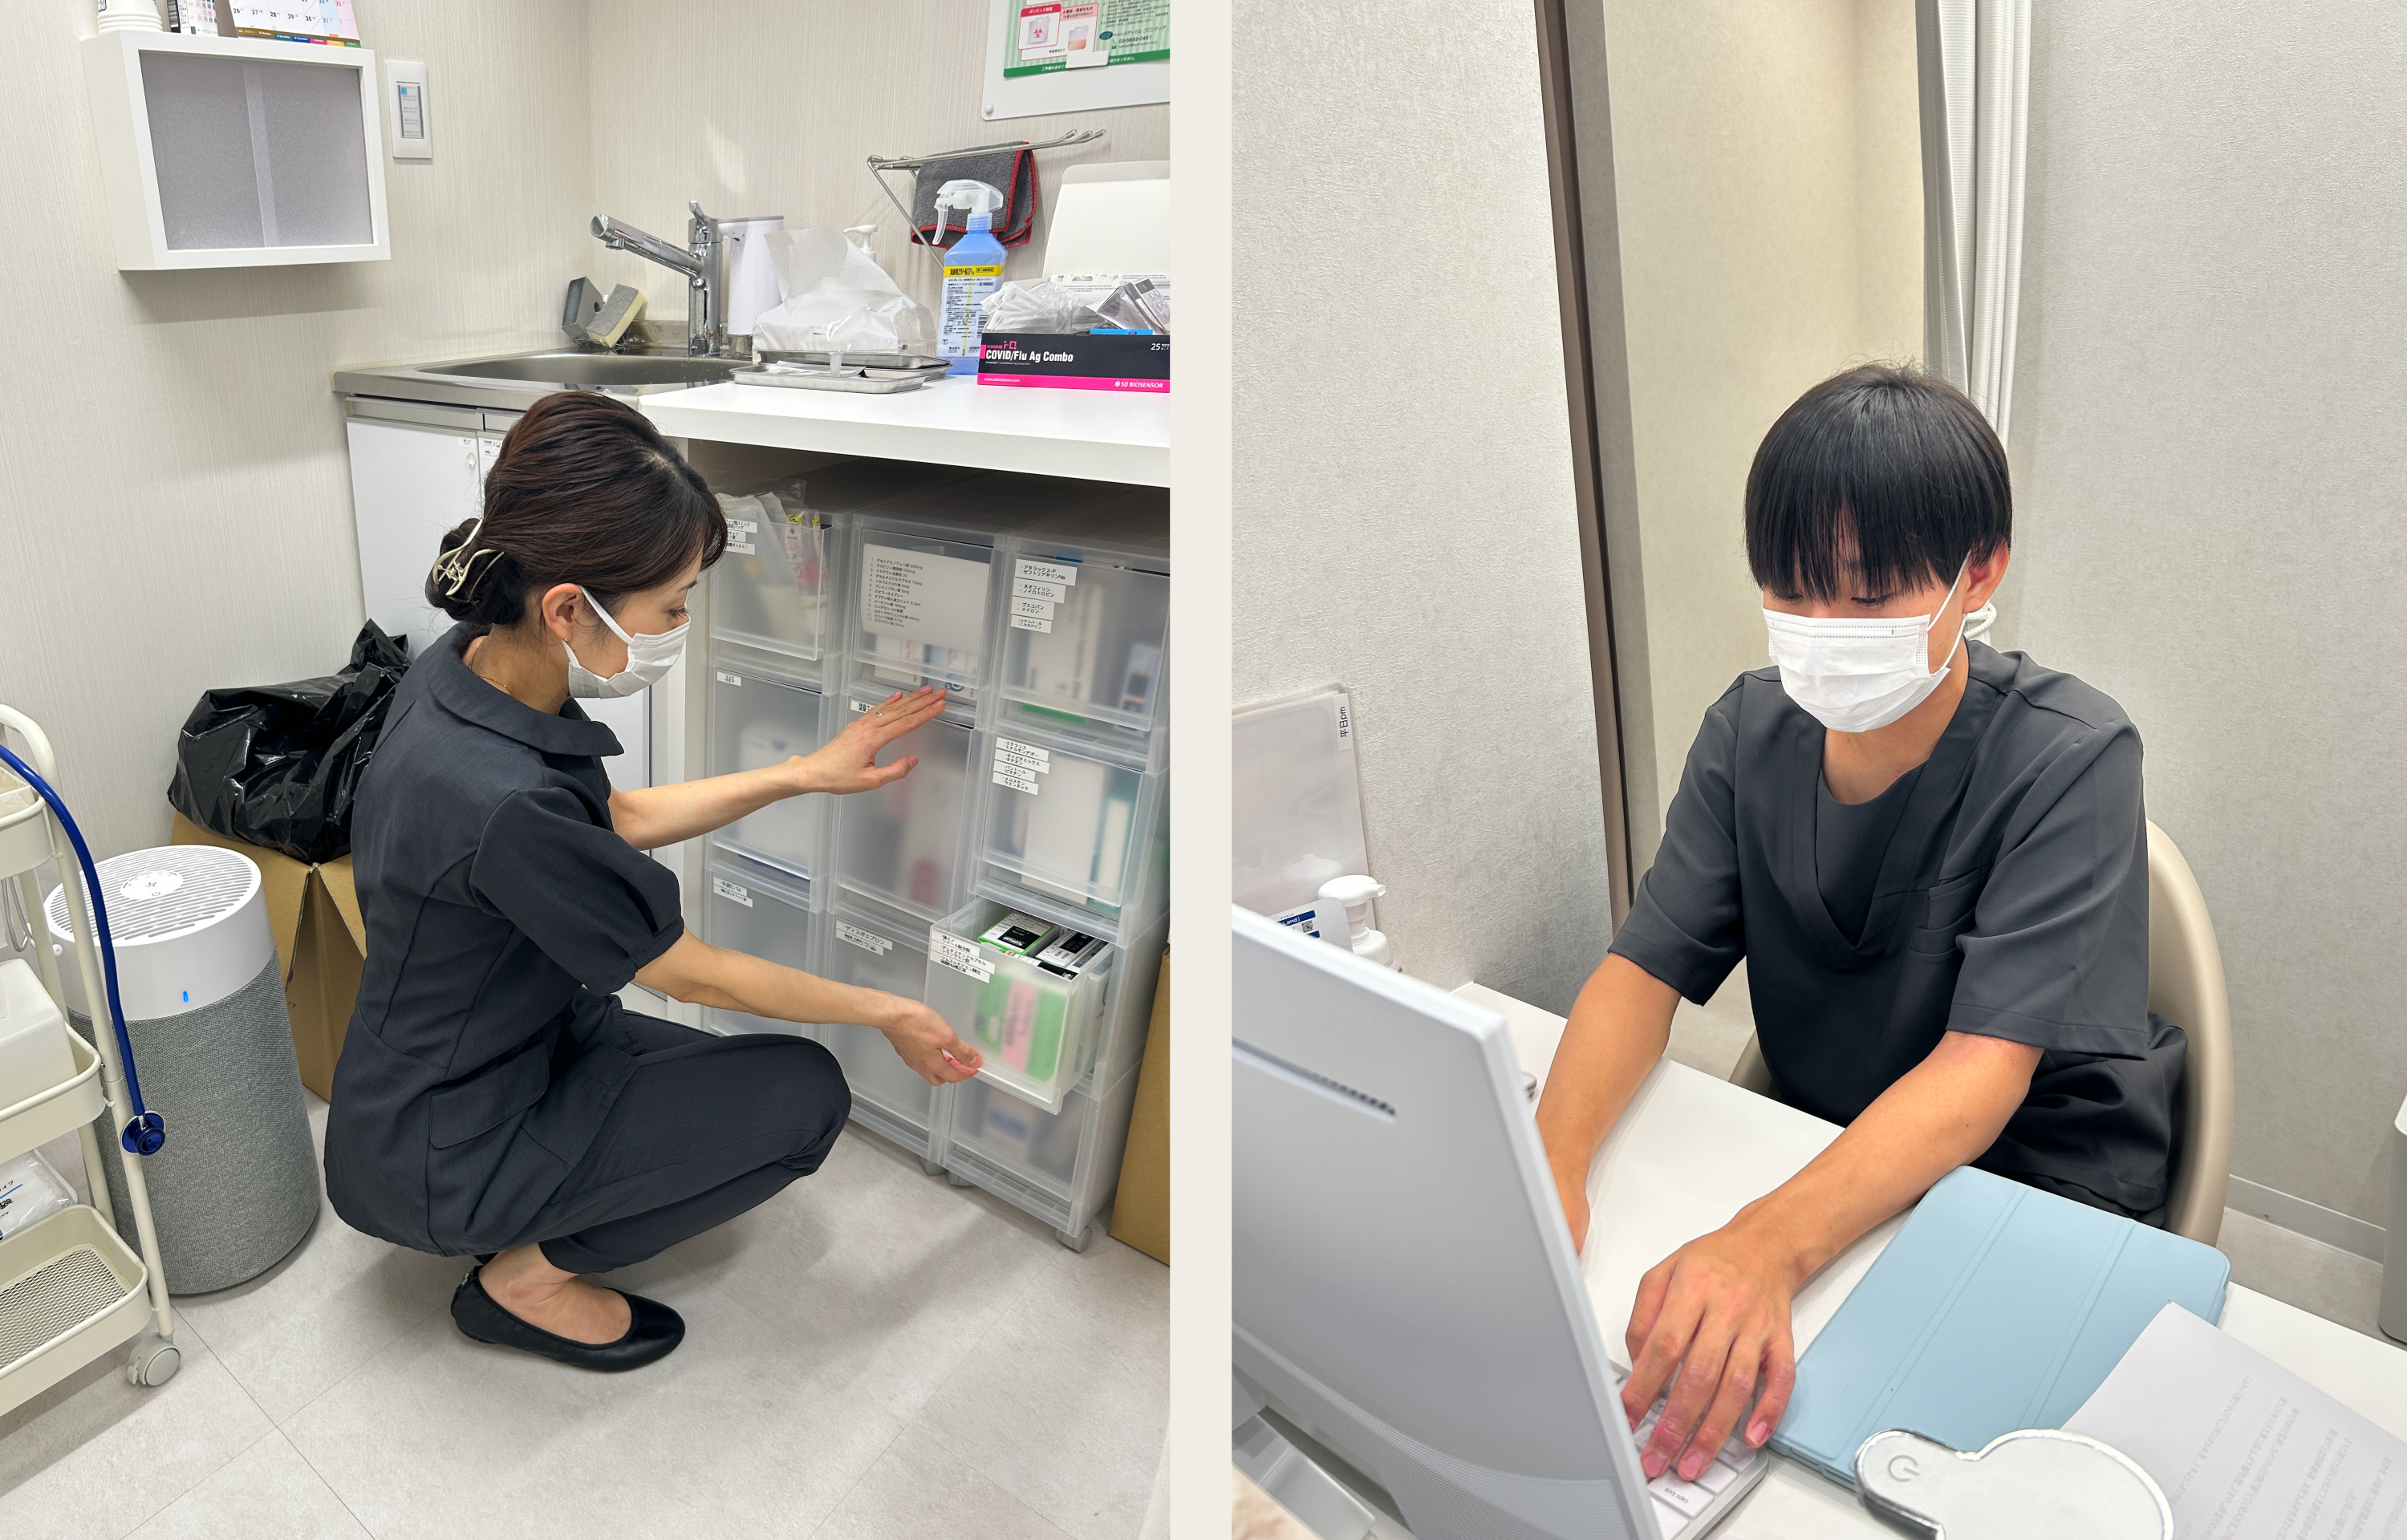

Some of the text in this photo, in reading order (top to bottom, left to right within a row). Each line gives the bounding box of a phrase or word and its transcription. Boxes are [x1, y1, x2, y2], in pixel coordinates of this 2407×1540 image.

[1151, 342, 1161, 351] 25
[985, 350, 1074, 363] COVID/Flu Ag Combo
[1023, 569, 1065, 580] セフトリアキソンNa
[1024, 584, 1051, 592] ネオフィリン
[1023, 590, 1055, 598] ノイロトロピン
[1339, 706, 1350, 738] 平日pm
[1005, 745, 1039, 756] エナルモンデポー
[1006, 757, 1023, 765] タチオン
[846, 926, 884, 945] ディスポエプロン
[1664, 1487, 1689, 1504] caps lock
